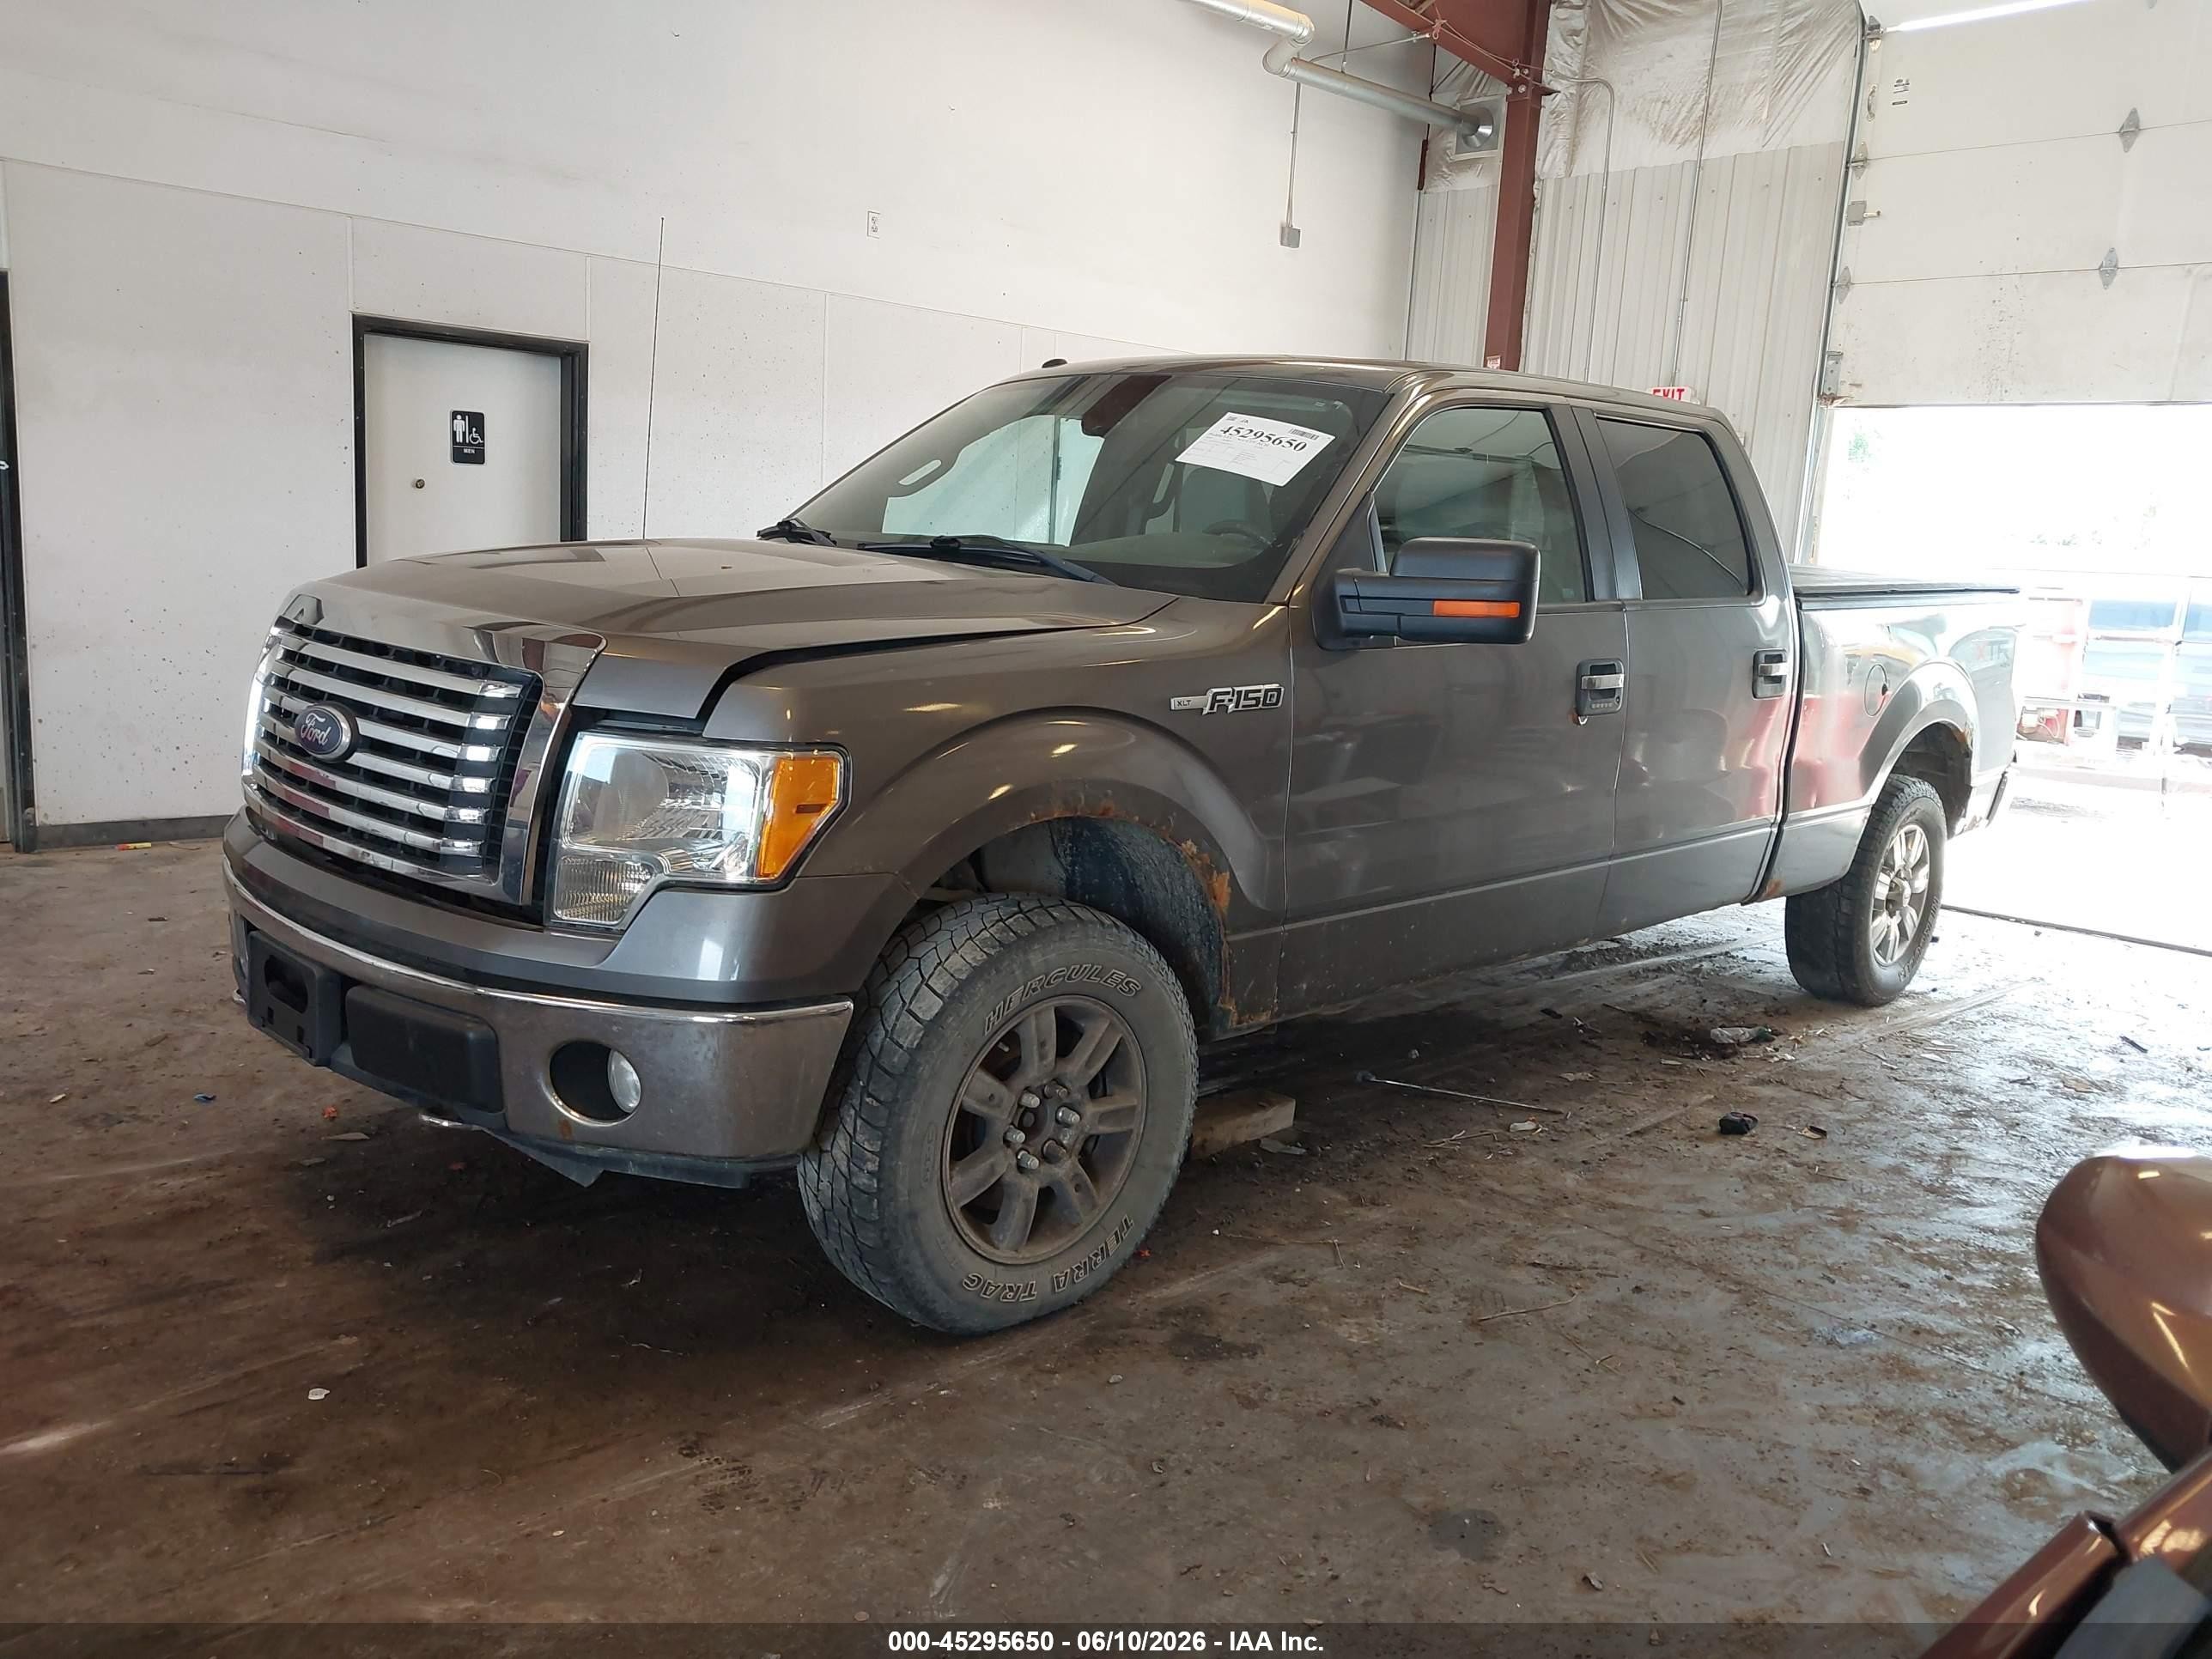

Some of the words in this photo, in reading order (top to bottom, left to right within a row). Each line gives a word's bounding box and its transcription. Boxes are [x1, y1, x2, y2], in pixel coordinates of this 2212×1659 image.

[1220, 425, 1307, 453] 45295650
[301, 713, 332, 745] Ford
[984, 963, 1142, 1036] HERCULES
[1052, 1214, 1134, 1292] TERRA
[962, 1273, 1038, 1303] TRAC
